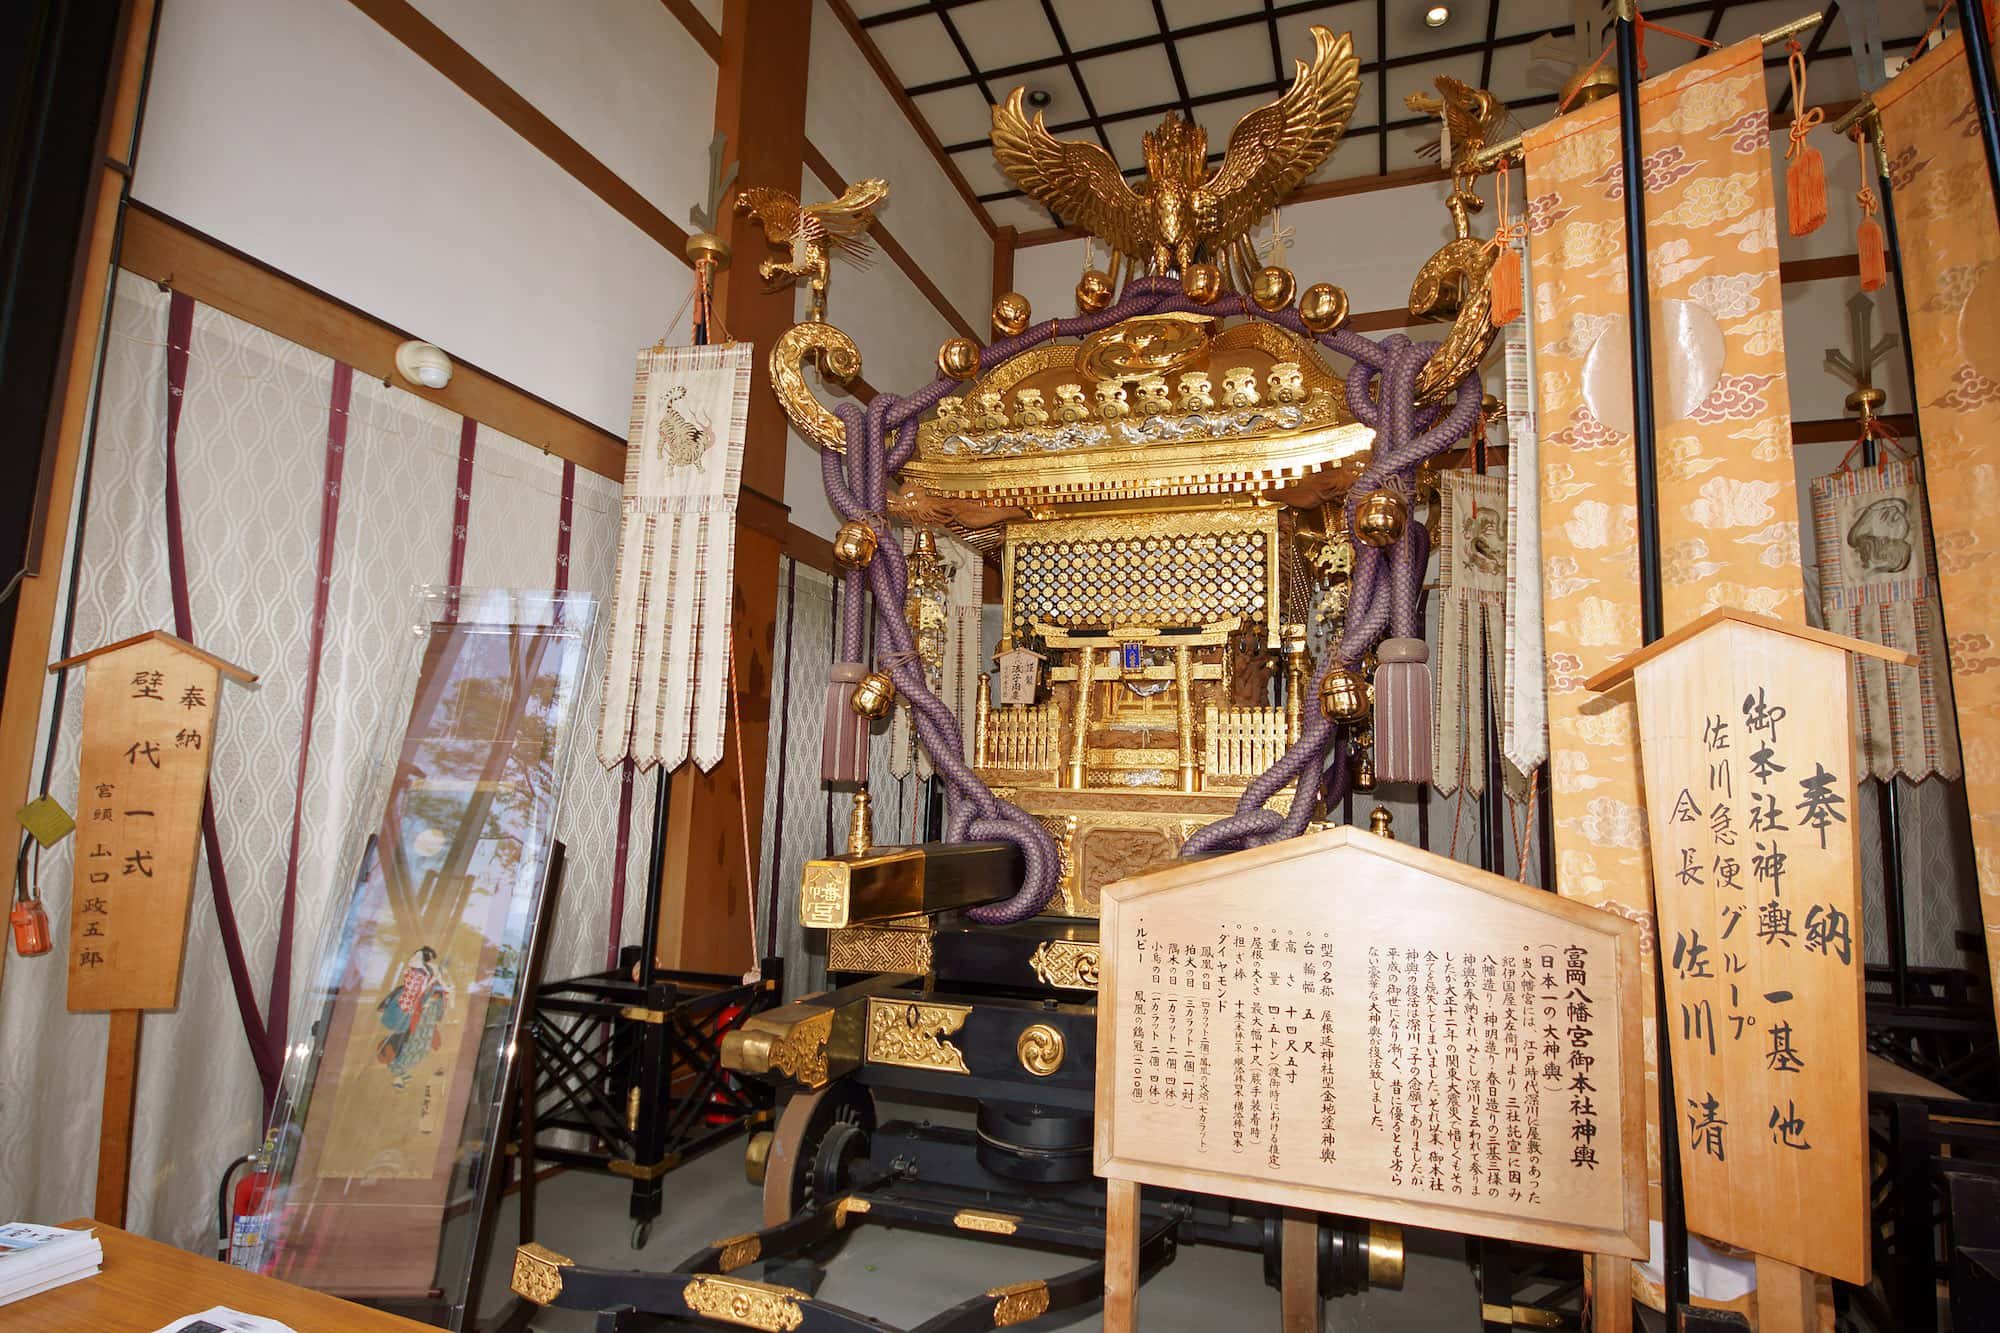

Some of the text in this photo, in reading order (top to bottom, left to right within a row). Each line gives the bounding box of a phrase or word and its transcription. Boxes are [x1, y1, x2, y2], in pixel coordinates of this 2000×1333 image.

[121, 670, 165, 878] 壁代一式
[174, 685, 207, 751] 奉納
[807, 869, 843, 923] 八幡宮
[1704, 713, 1756, 1042] 佐川急便グループ
[1795, 762, 1853, 966] 奉納
[1539, 944, 1564, 1092] （日本一の大神輿）
[1563, 944, 1599, 1170] 富岡八幡宮御本社神輿
